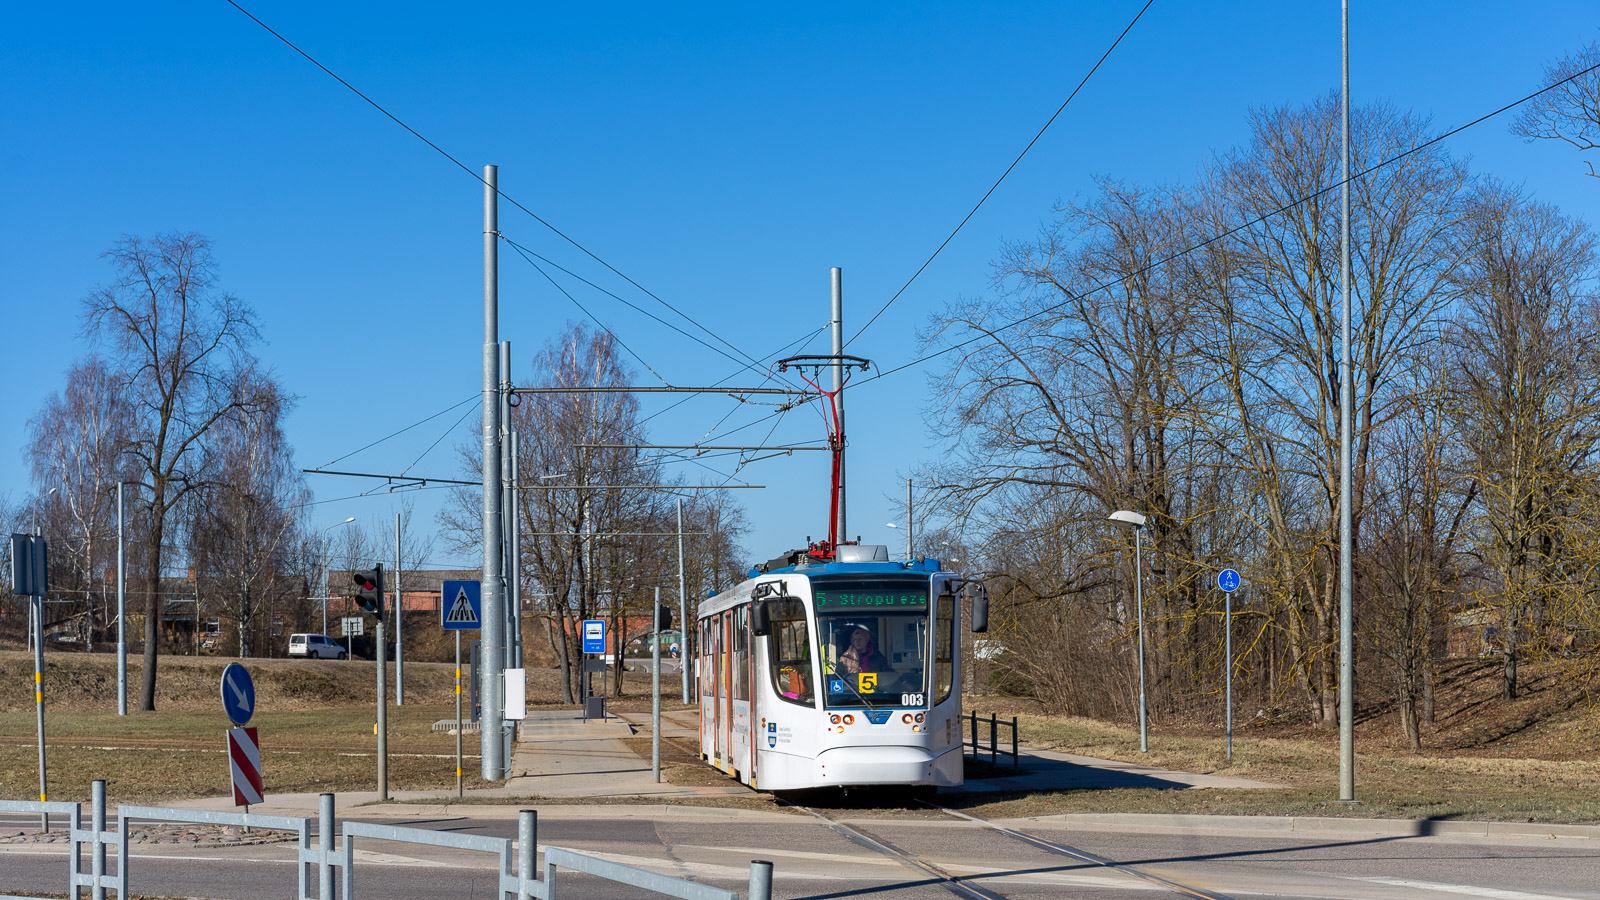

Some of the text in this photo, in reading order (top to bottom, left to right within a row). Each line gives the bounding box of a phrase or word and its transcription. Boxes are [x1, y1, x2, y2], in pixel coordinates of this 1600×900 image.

[840, 594, 894, 606] Stropu
[862, 676, 875, 690] 5
[902, 693, 924, 706] 003
